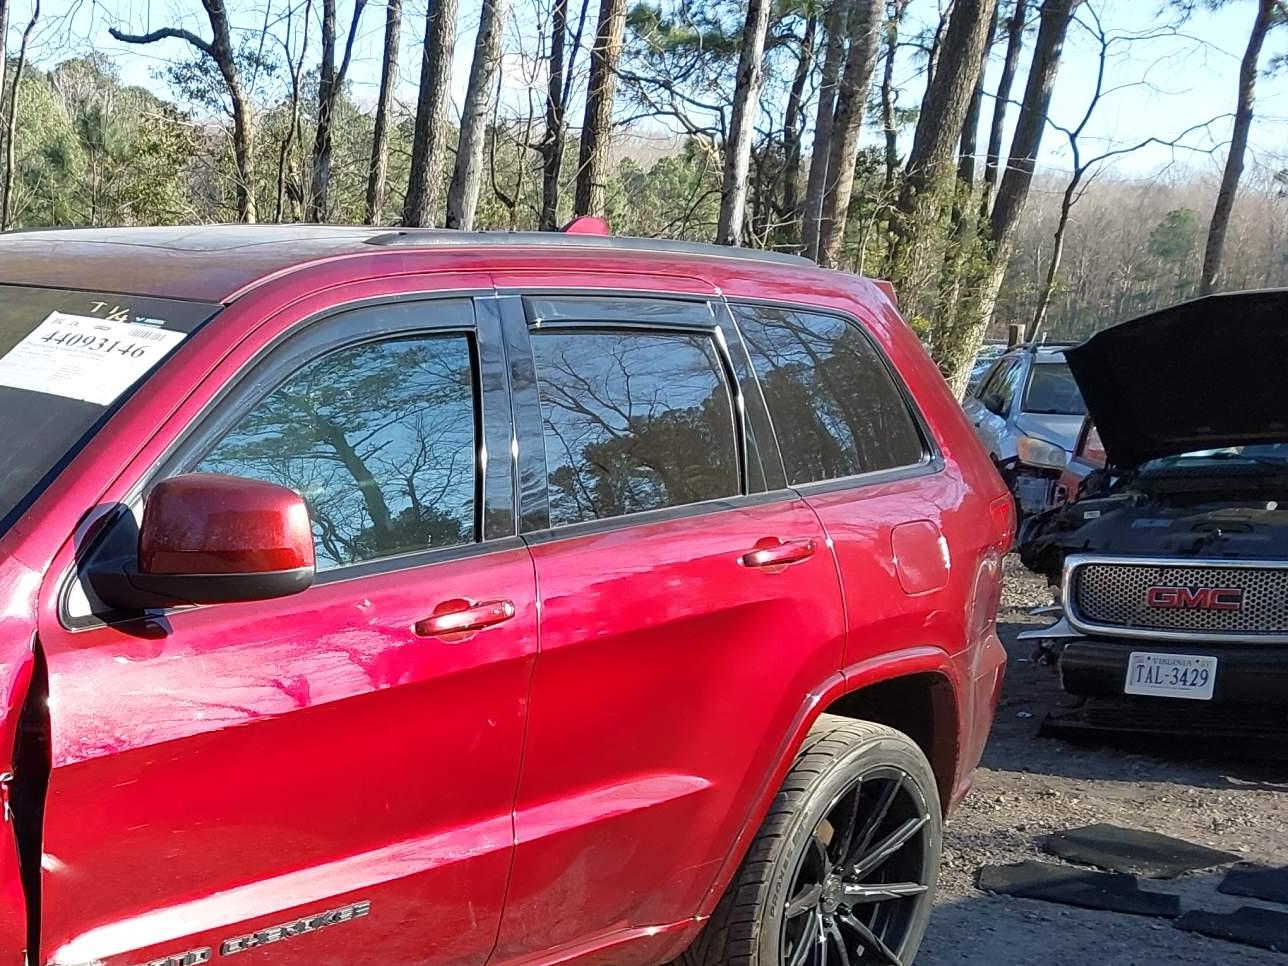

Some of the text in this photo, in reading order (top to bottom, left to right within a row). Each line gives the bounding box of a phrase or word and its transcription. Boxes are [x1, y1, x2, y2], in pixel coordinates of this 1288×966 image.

[40, 330, 152, 359] 44093146
[1146, 586, 1242, 610] GMC
[1136, 664, 1209, 688] TAL-3429
